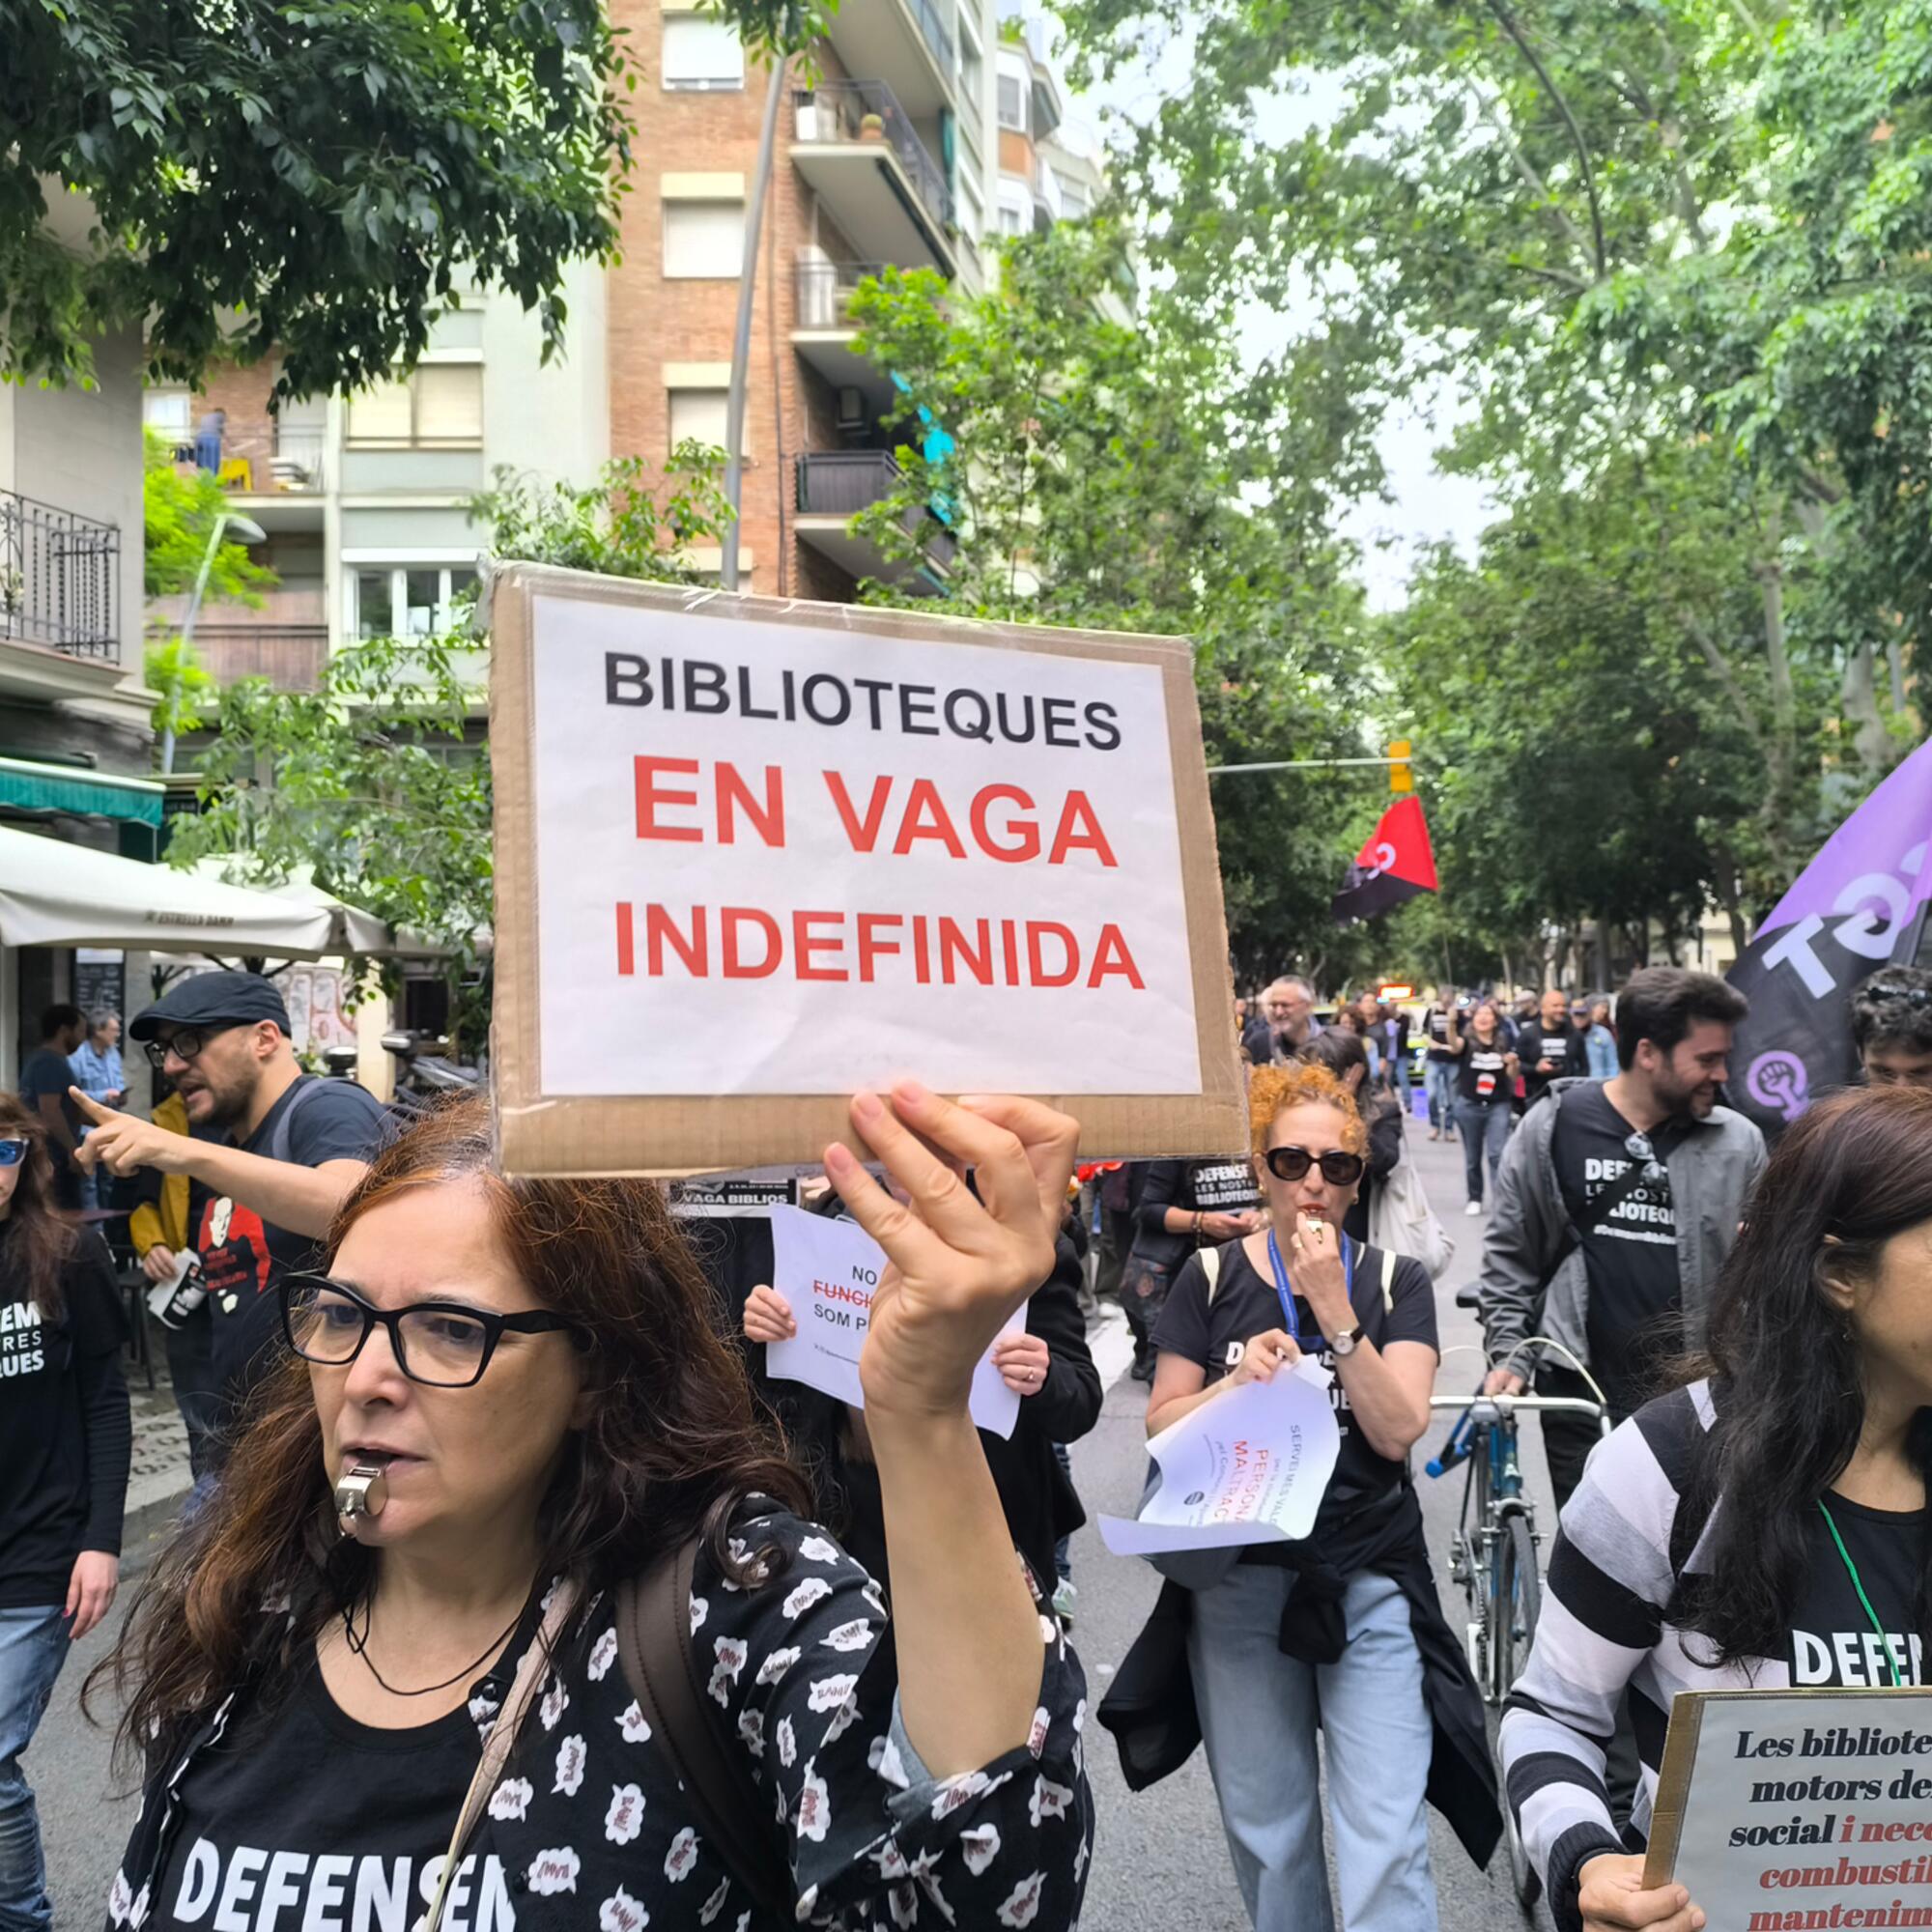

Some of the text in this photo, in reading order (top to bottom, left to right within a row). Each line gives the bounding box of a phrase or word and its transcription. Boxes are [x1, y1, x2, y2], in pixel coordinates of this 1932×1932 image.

[604, 651, 1122, 752] BIBLIOTEQUES
[633, 753, 1119, 867] EN VAGA
[615, 901, 1147, 990] INDEFINIDA
[728, 1193, 788, 1205] BIBLIOS
[852, 1265, 877, 1286] NO
[813, 1279, 873, 1308] FUNCI
[0, 1300, 42, 1333] EM
[813, 1303, 850, 1327] SOM
[0, 1350, 44, 1378] UES
[1288, 1424, 1303, 1472] SERVEI
[1213, 1440, 1249, 1520] MALTRAC
[1734, 1726, 1932, 1758] Les bibliote
[1749, 1776, 1883, 1803] motors
[1728, 1814, 1836, 1847] social
[1838, 1814, 1857, 1843] i
